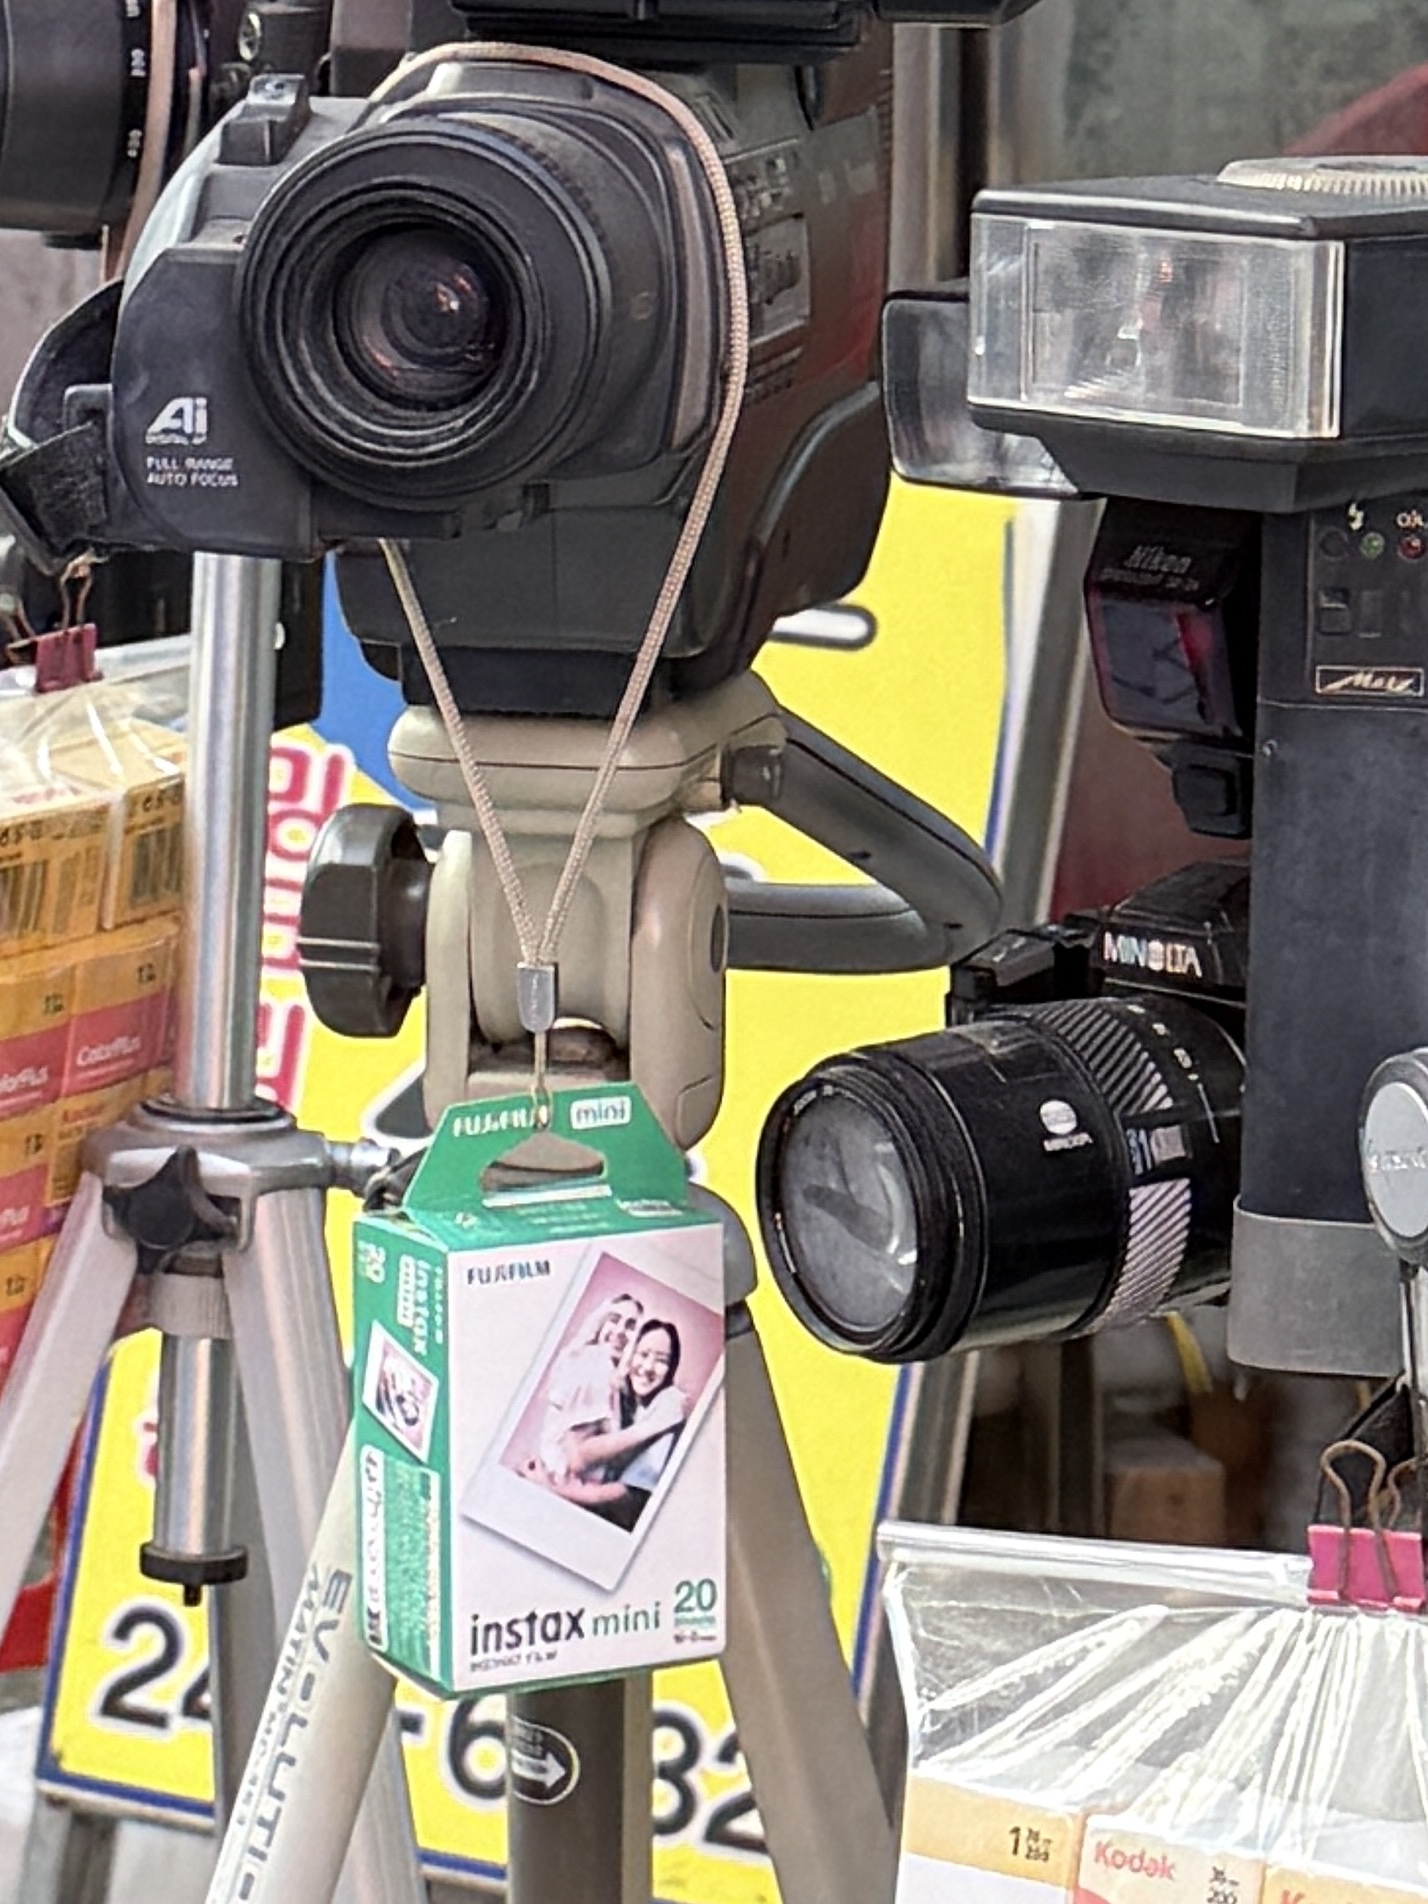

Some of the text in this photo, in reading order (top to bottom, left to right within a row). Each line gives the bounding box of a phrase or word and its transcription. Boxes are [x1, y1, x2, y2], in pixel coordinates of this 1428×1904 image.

[146, 471, 239, 488] AUTO FOCUS
[1123, 542, 1194, 576] Nikon
[1102, 931, 1204, 979] MINOLTA
[575, 1100, 626, 1124] mini
[466, 1258, 552, 1287] FUJIFILM
[470, 1577, 718, 1658] instax mini 20
[1094, 1839, 1177, 1882] Kodak
